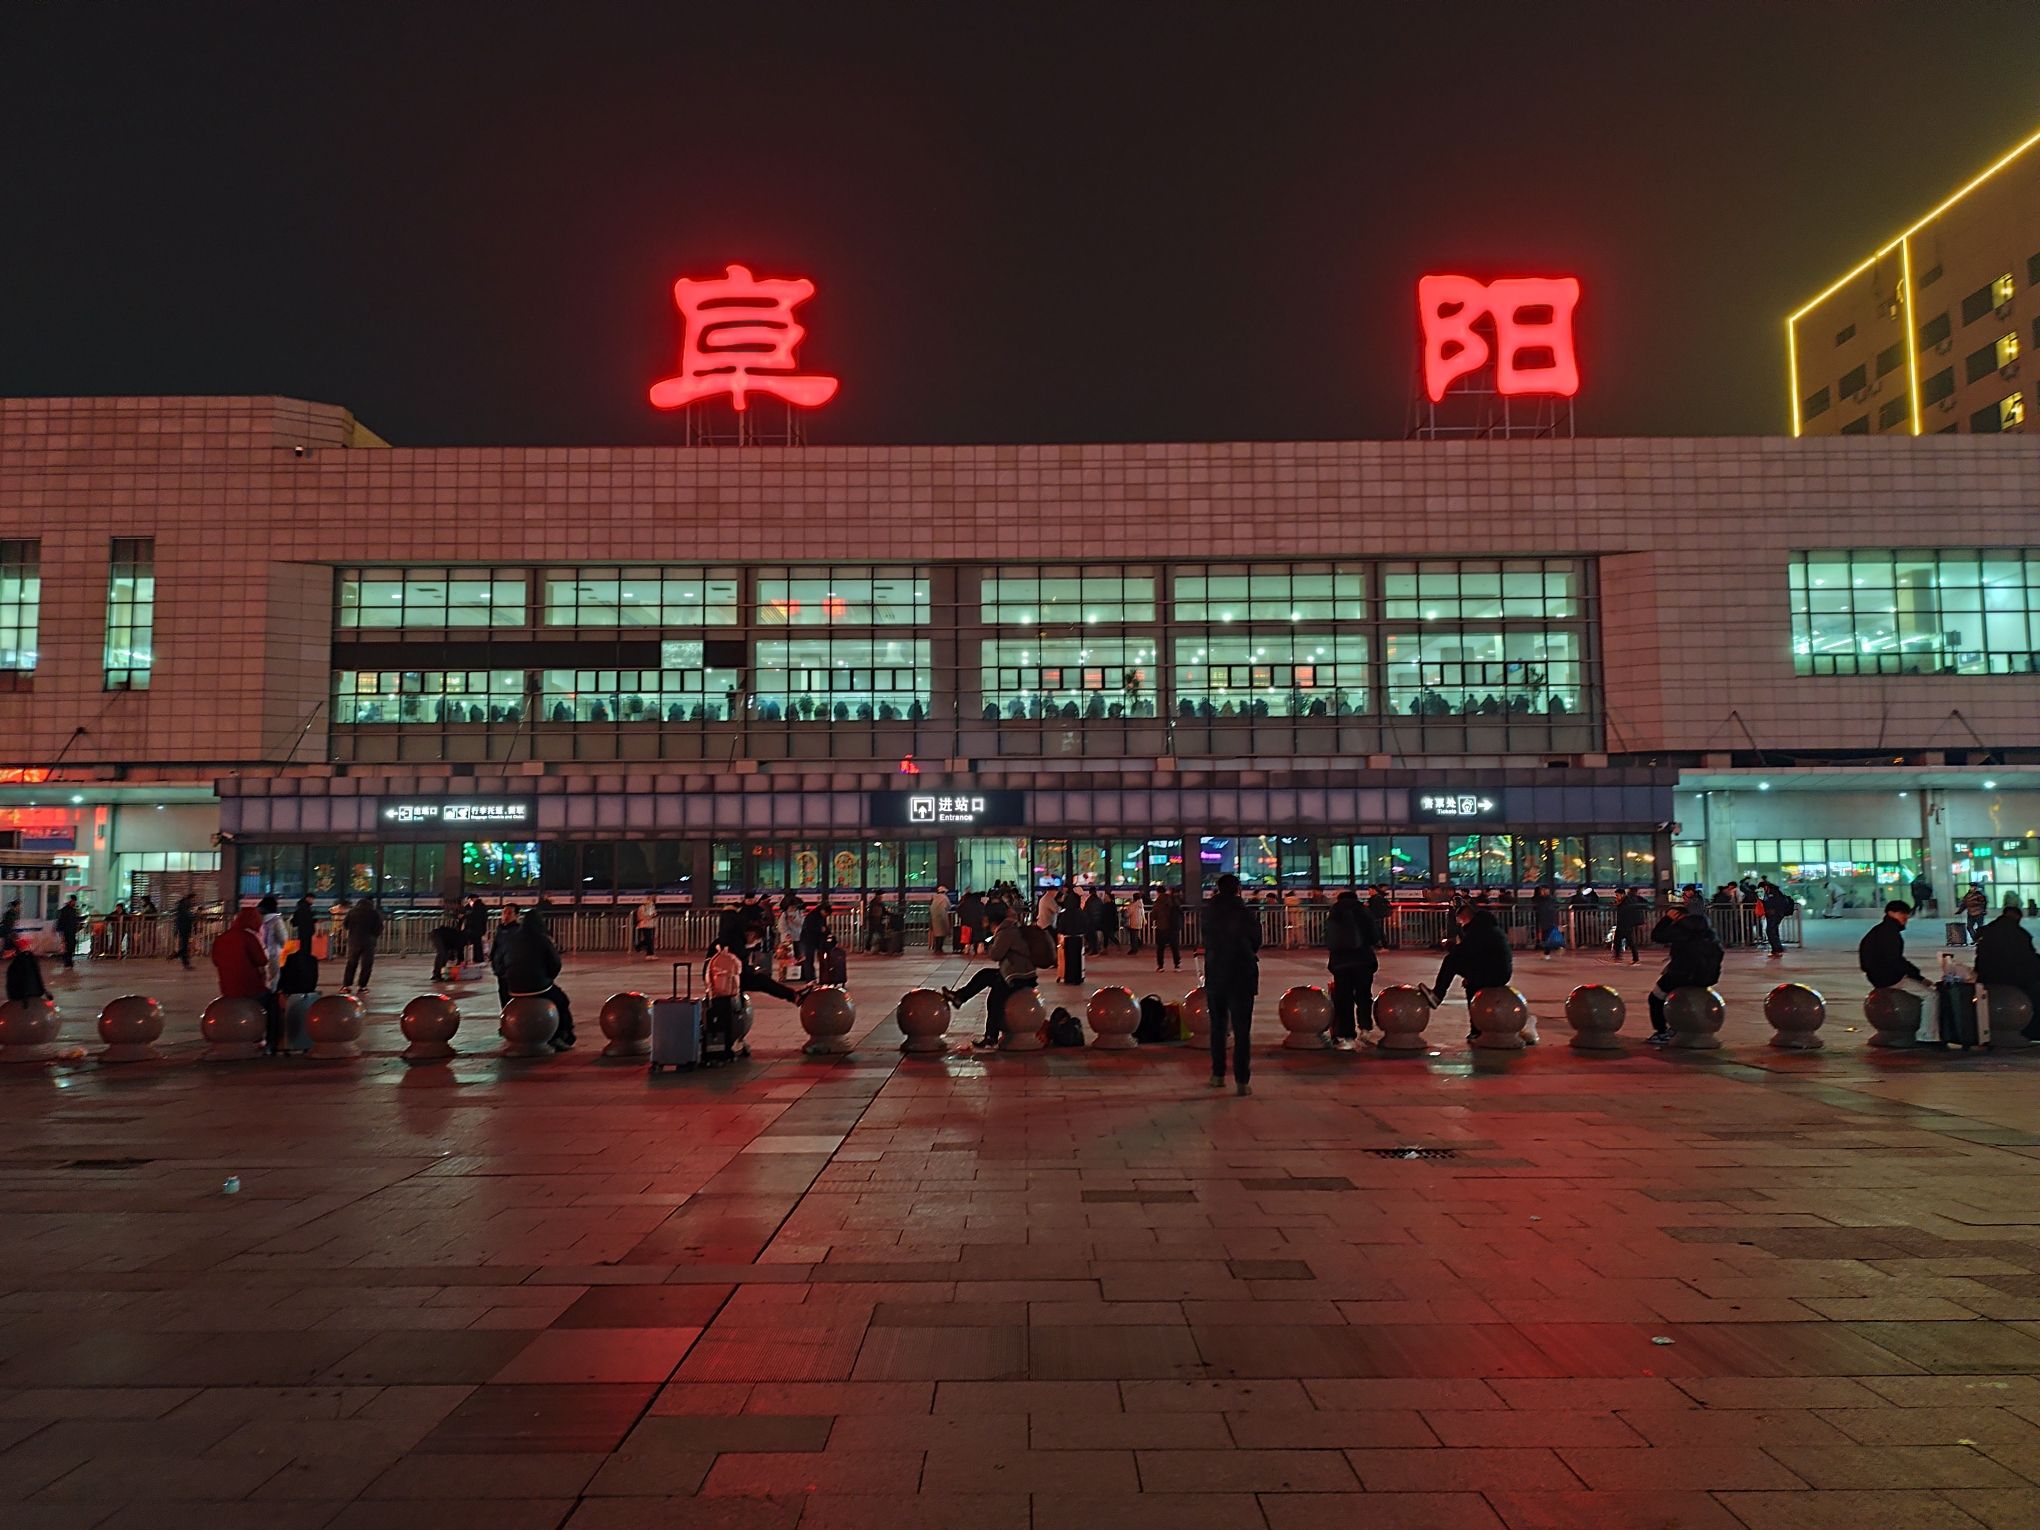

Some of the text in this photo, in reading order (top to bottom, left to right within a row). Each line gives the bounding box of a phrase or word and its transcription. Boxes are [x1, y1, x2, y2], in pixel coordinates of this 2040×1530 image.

[650, 264, 1580, 411] 阜 阳
[938, 796, 984, 812] 进站口
[1423, 797, 1457, 809] 售票处
[939, 813, 974, 821] Entrance
